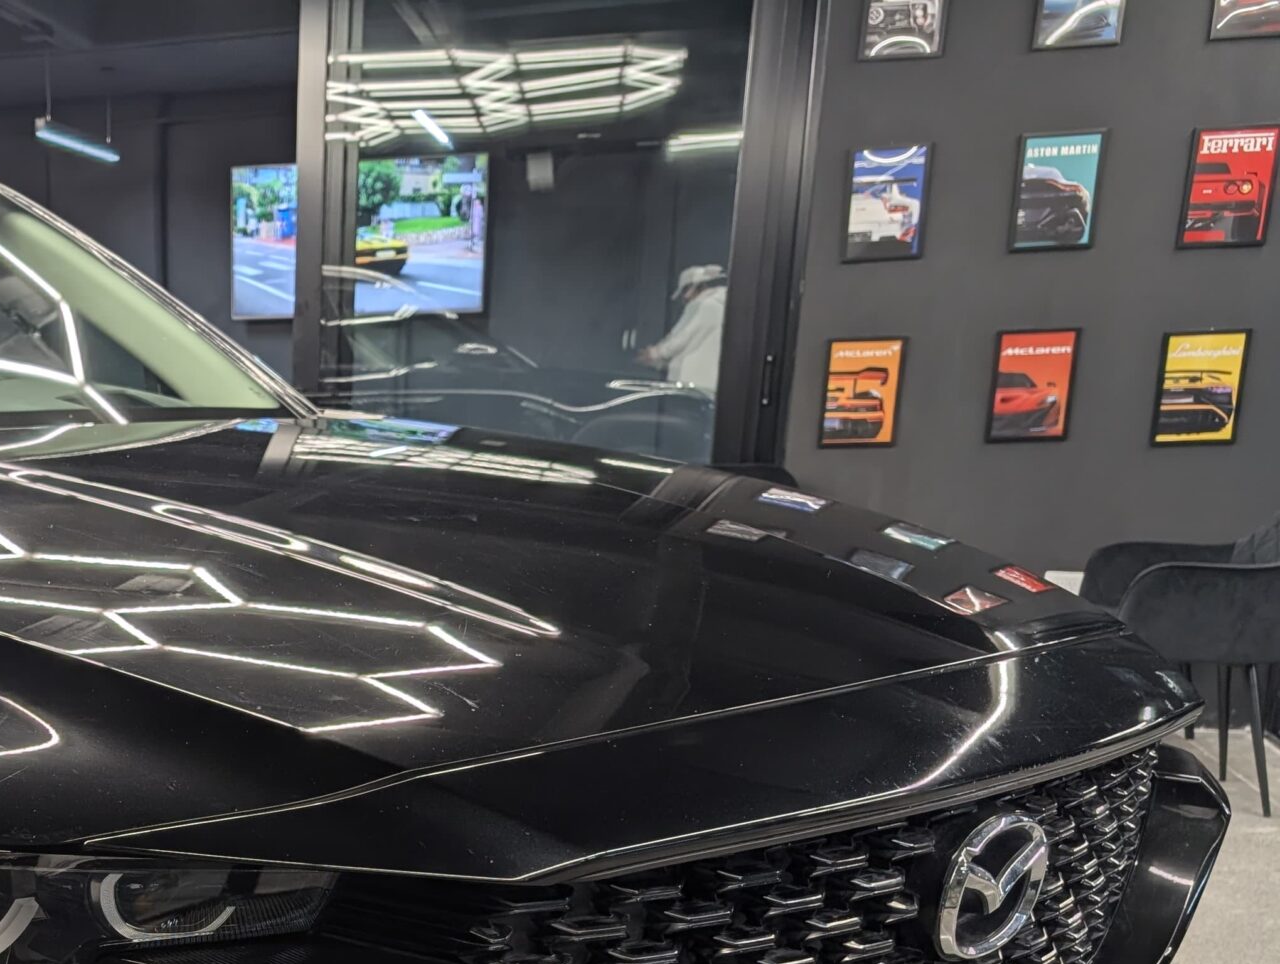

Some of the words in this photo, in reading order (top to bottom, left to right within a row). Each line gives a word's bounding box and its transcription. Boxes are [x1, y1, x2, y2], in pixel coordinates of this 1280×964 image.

[1200, 132, 1275, 154] Ferrari
[1026, 147, 1058, 158] ASTON
[1061, 144, 1098, 156] MARTIN
[1002, 345, 1072, 356] McLaren
